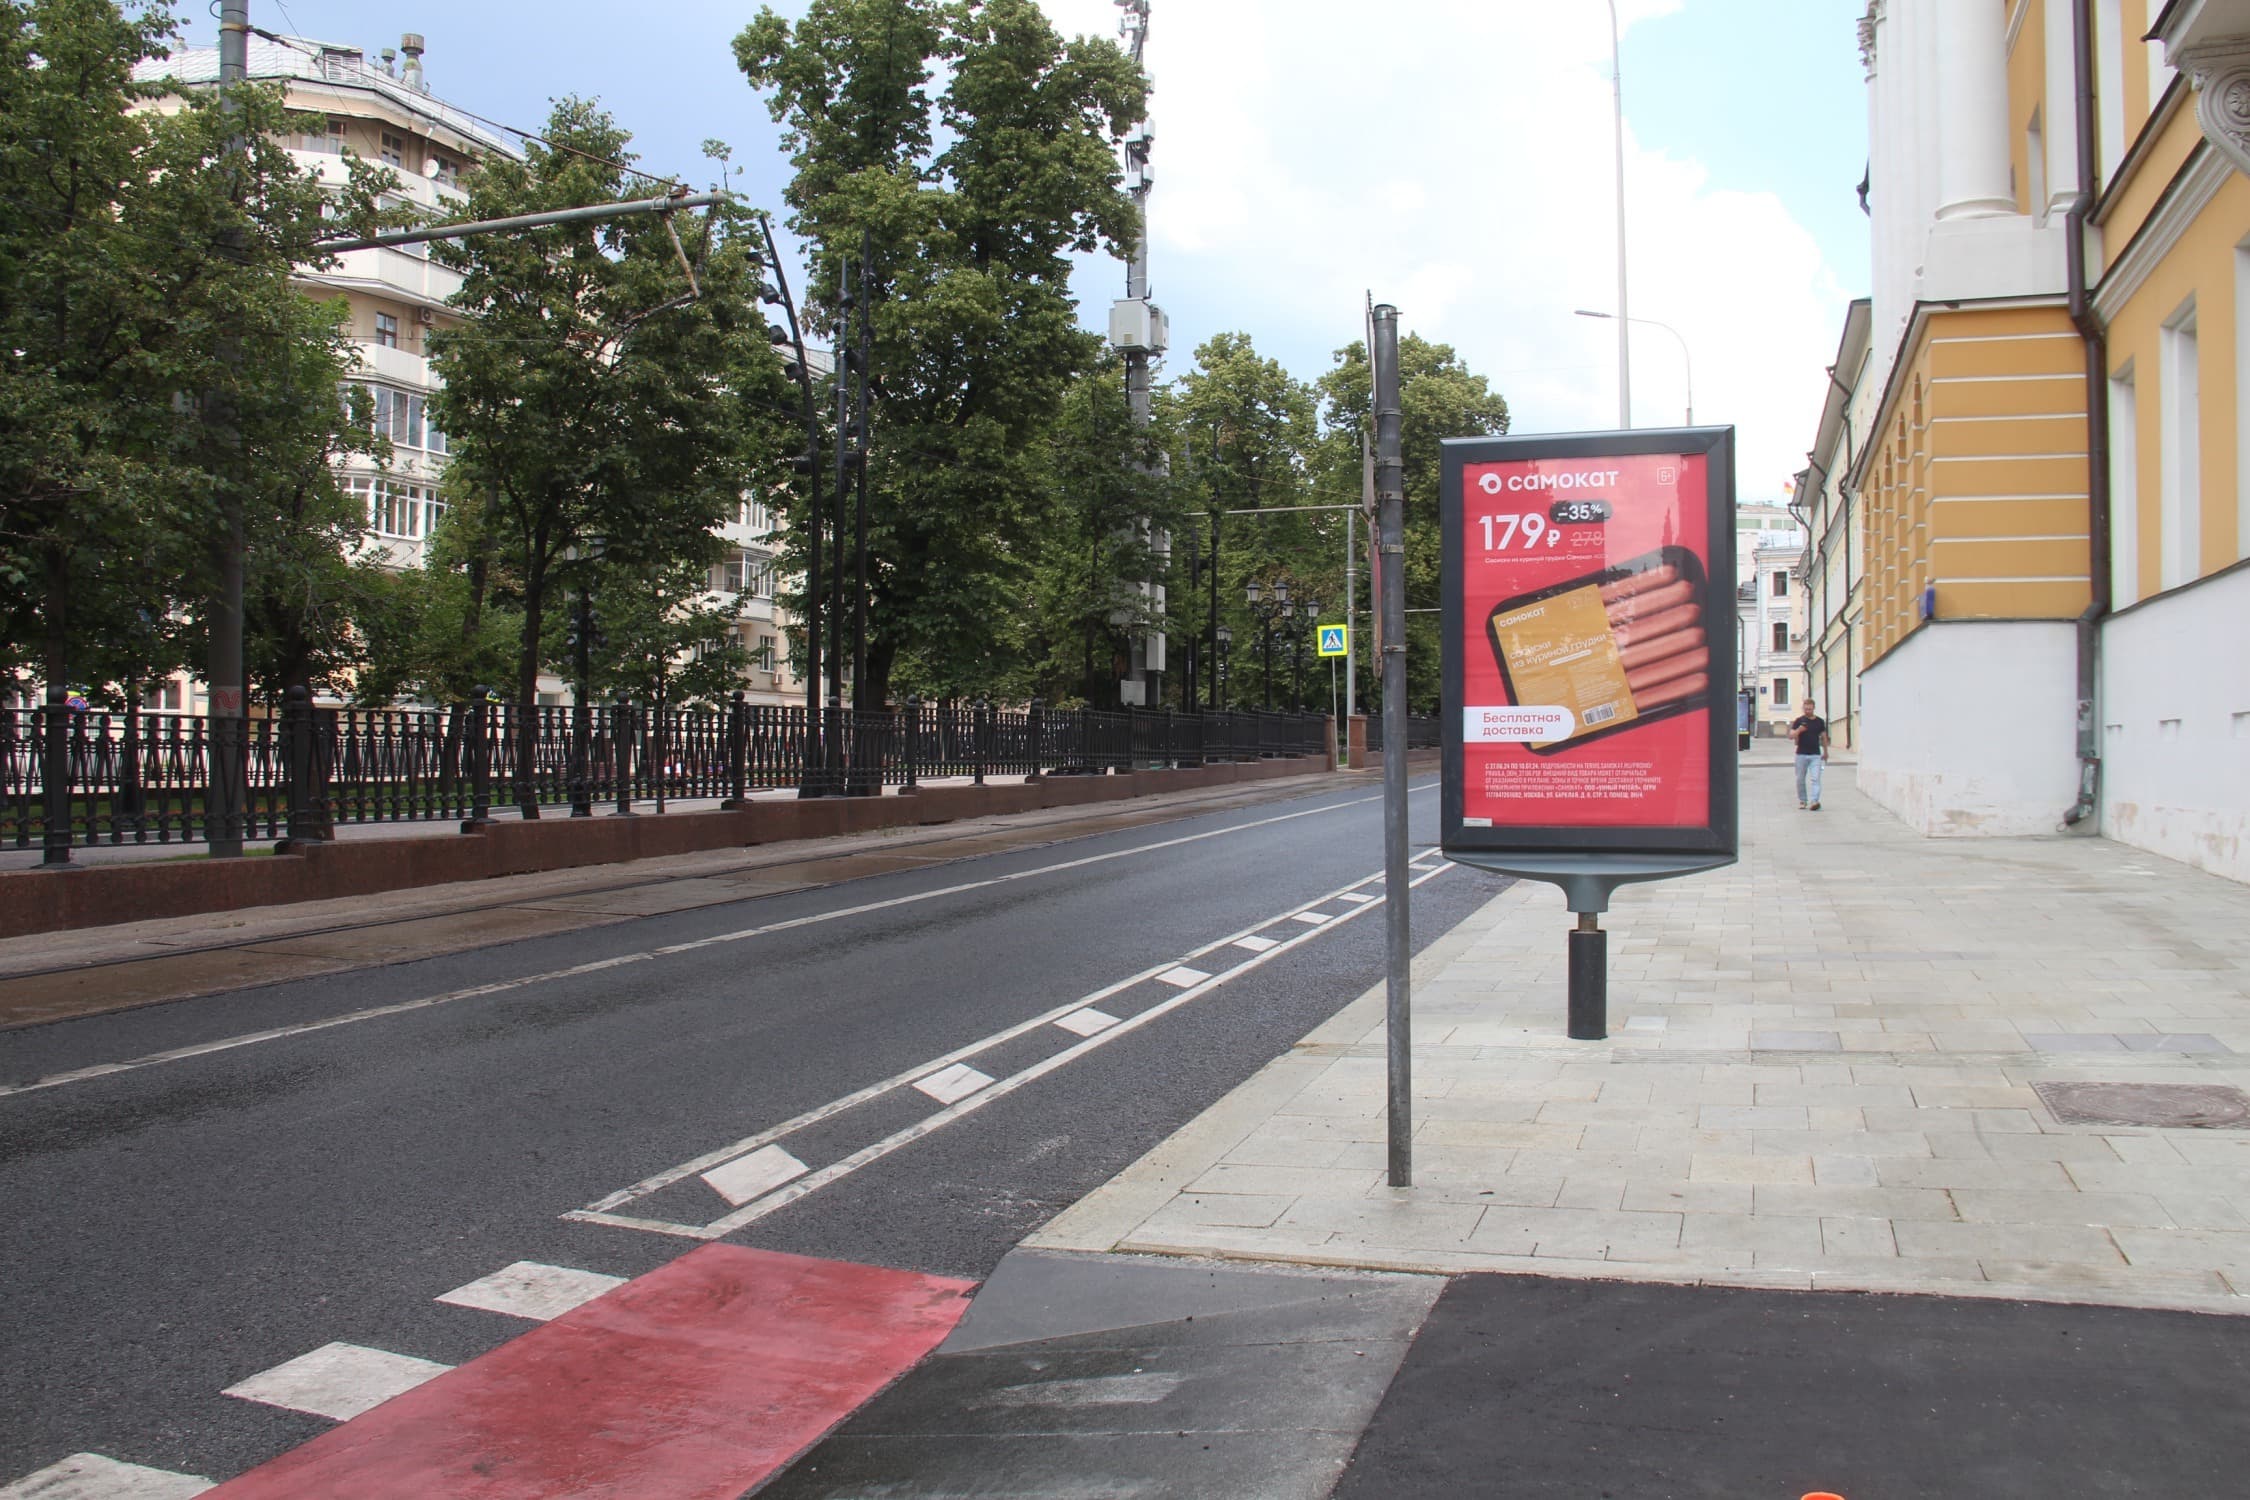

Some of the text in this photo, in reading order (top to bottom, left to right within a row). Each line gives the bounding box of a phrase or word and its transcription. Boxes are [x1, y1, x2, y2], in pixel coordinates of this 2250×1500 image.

[1508, 471, 1619, 491] самокат
[1661, 470, 1673, 482] 6+
[1500, 607, 1545, 627] самокат
[1483, 712, 1560, 723] Бесплатная
[1483, 726, 1543, 736] доставка
